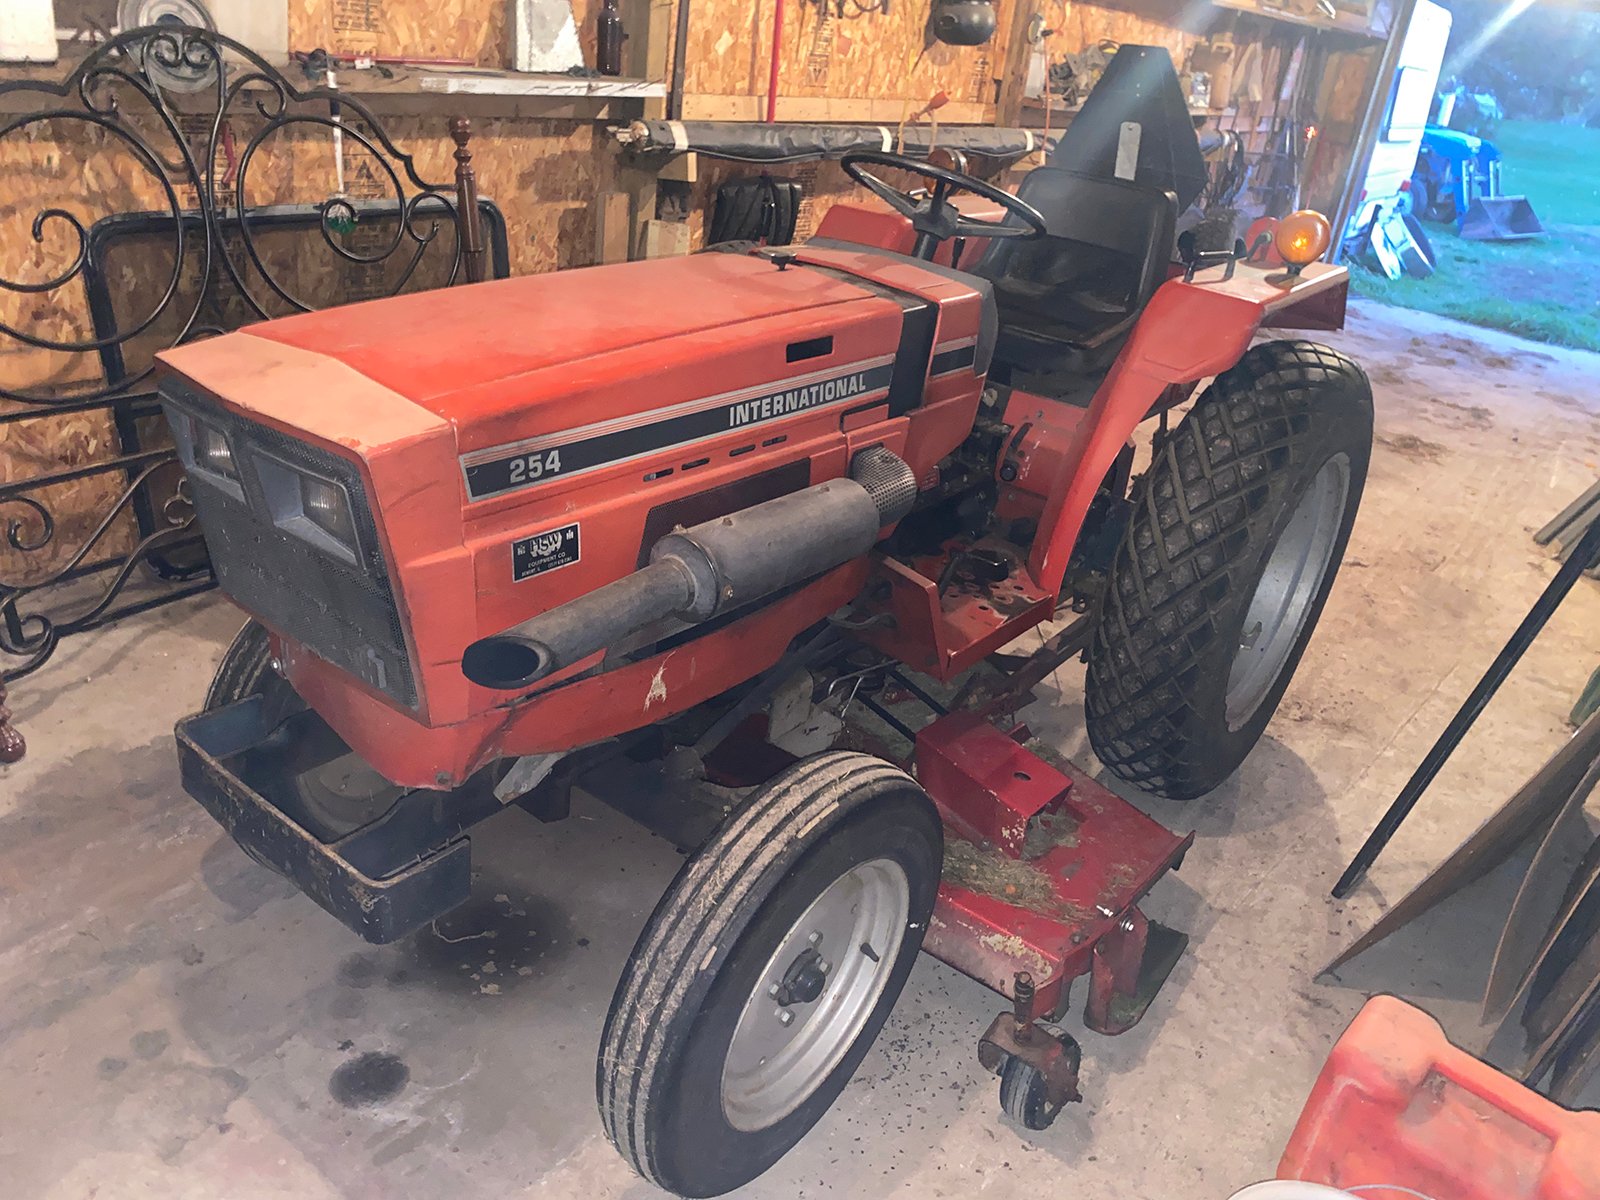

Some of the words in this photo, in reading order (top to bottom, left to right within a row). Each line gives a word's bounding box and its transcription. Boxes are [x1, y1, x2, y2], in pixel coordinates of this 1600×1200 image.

[729, 374, 866, 427] INTERNATIONAL
[509, 449, 561, 484] 254
[529, 531, 563, 558] HSW
[527, 554, 557, 569] EQUIPMENT
